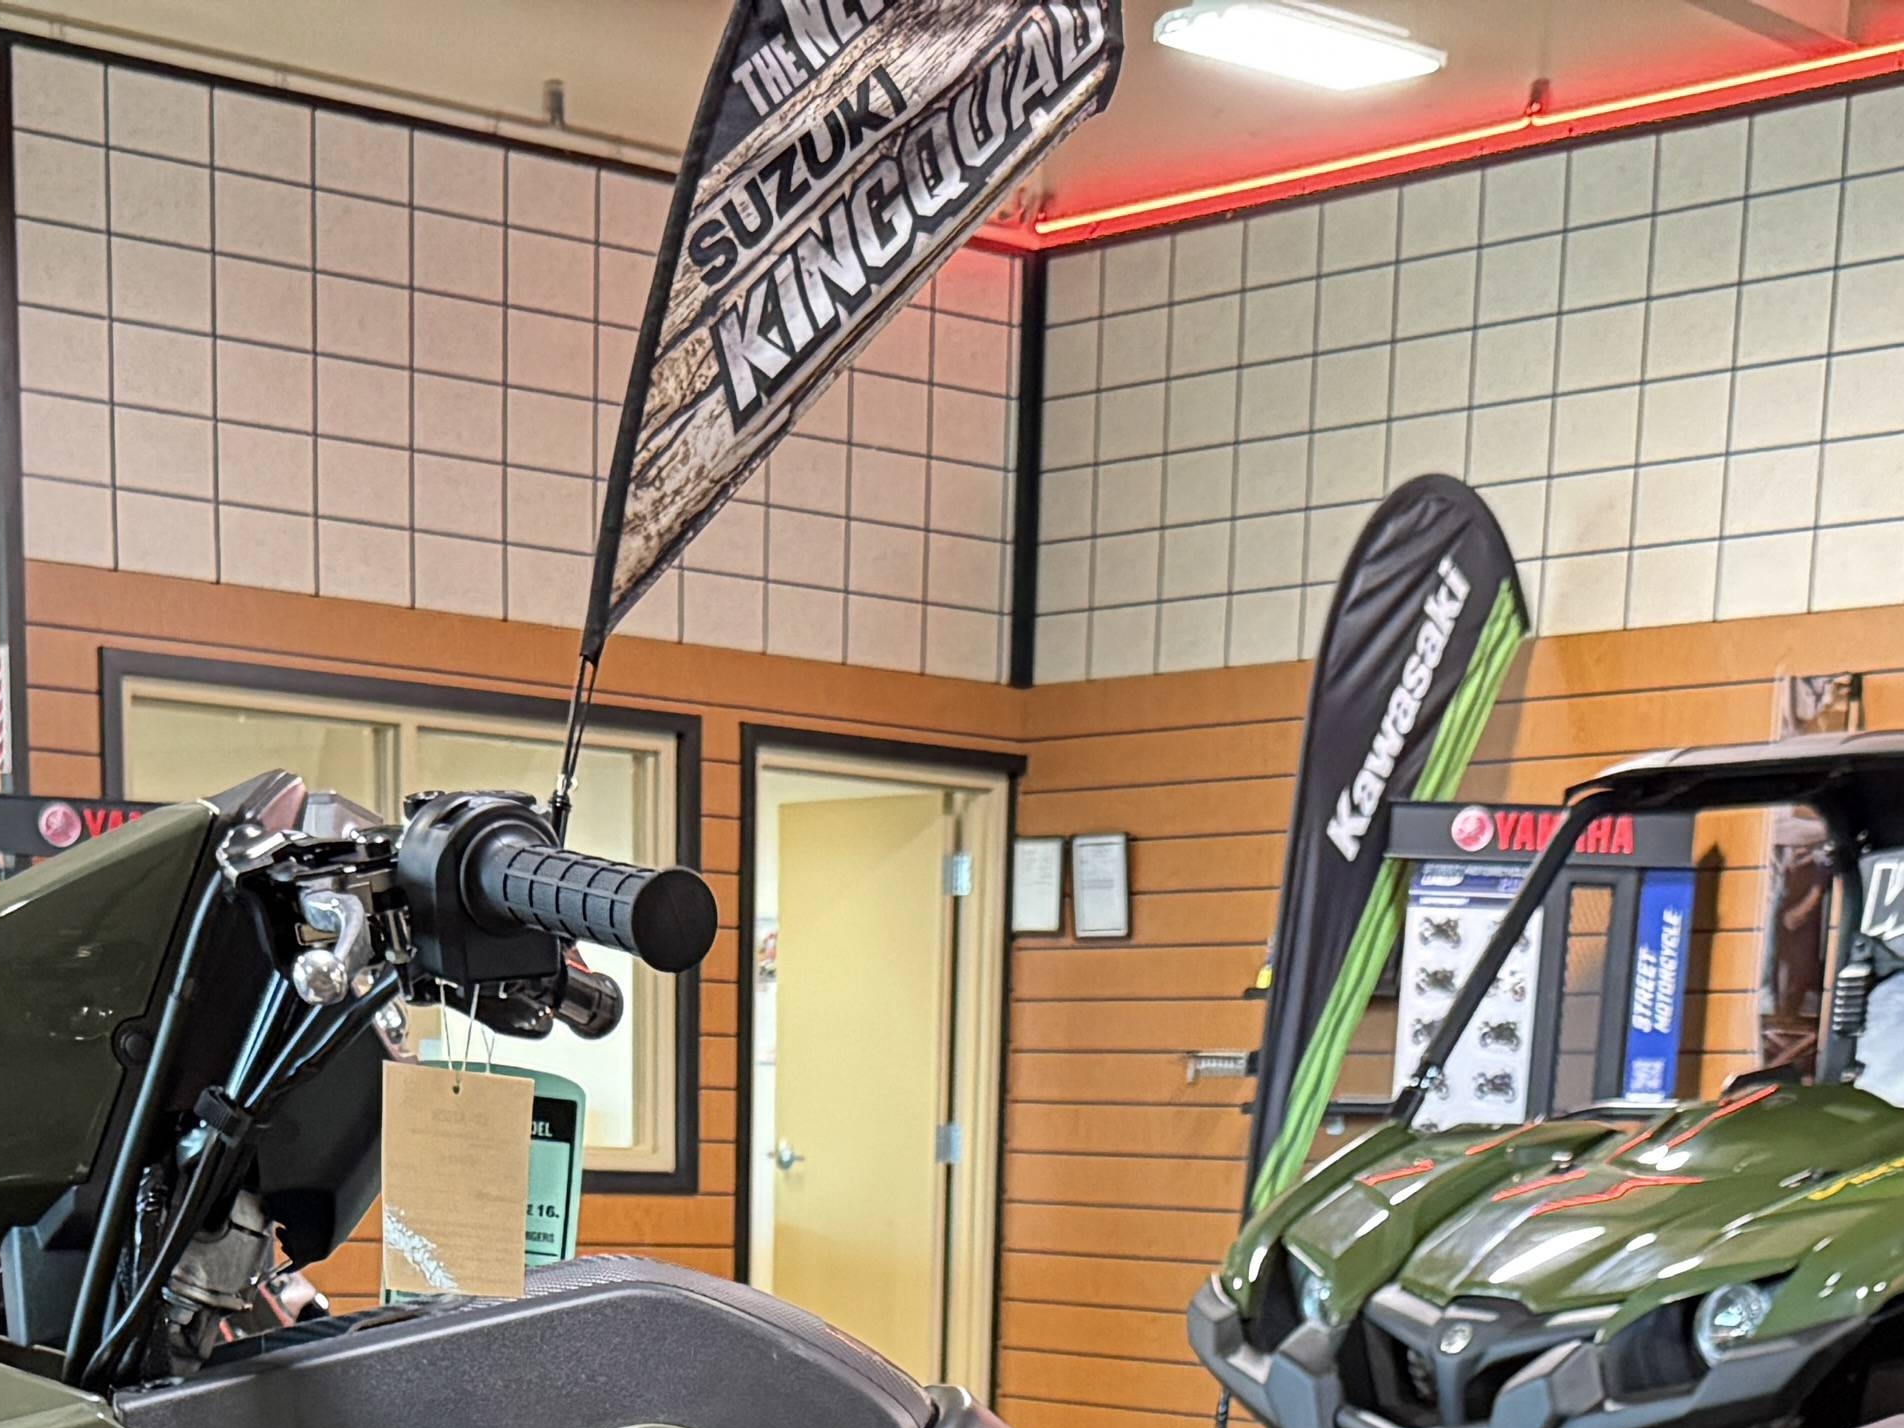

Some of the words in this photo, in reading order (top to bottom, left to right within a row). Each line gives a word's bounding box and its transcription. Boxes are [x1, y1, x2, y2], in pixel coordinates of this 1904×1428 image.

[732, 34, 808, 116] THE
[783, 0, 893, 71] NE
[690, 68, 908, 286] SUZUKI
[718, 0, 1104, 412] KINGQUAD
[1326, 555, 1471, 862] Kawasaki
[1494, 811, 1633, 854] YAMHA
